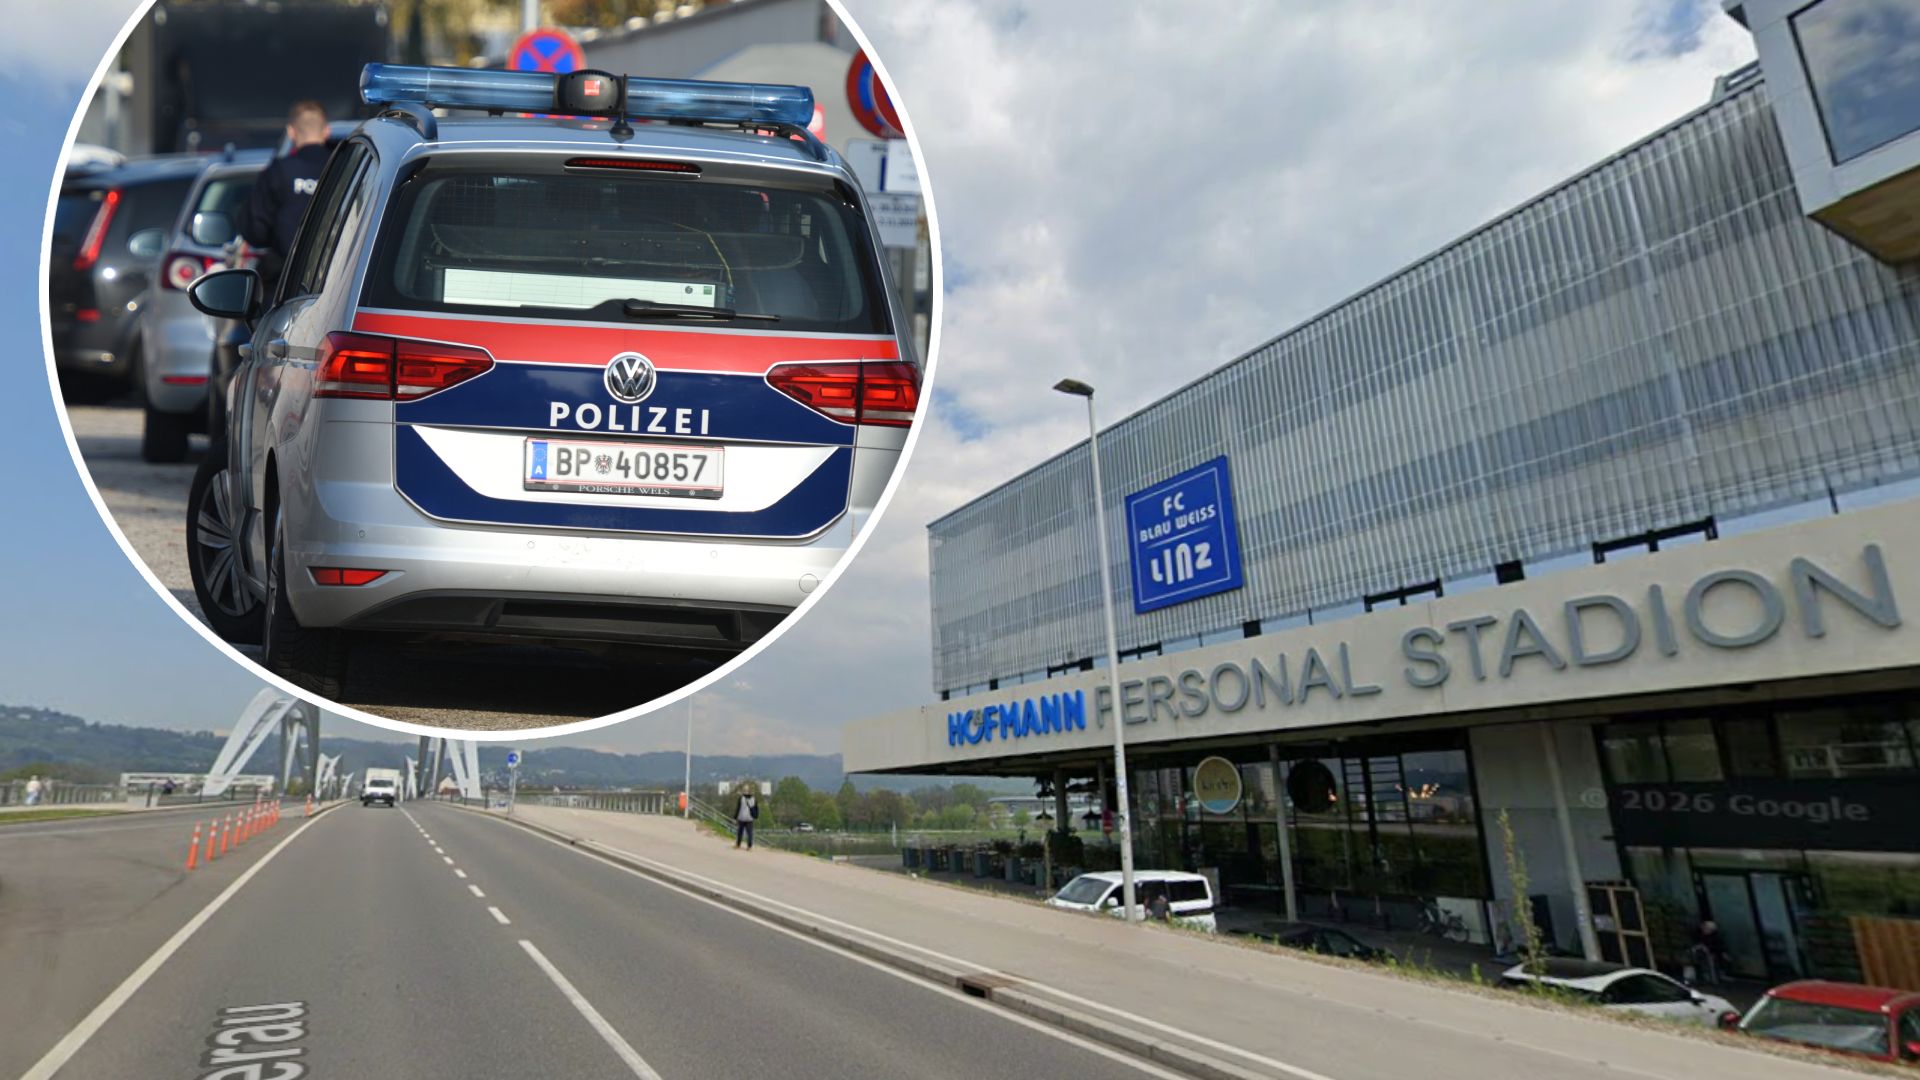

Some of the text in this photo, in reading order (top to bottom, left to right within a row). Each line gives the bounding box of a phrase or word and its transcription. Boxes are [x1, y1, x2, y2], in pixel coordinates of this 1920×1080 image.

[294, 178, 319, 194] PO
[550, 401, 710, 435] POLIZEI
[534, 465, 543, 475] A
[556, 447, 708, 482] BP 40857
[578, 485, 671, 495] PORSCHE WELS
[1162, 491, 1185, 517] FC
[1139, 504, 1216, 543] BLAU WEISS
[1150, 541, 1212, 585] LINZ
[948, 543, 1902, 747] HOFMANN PERSONAL STADION
